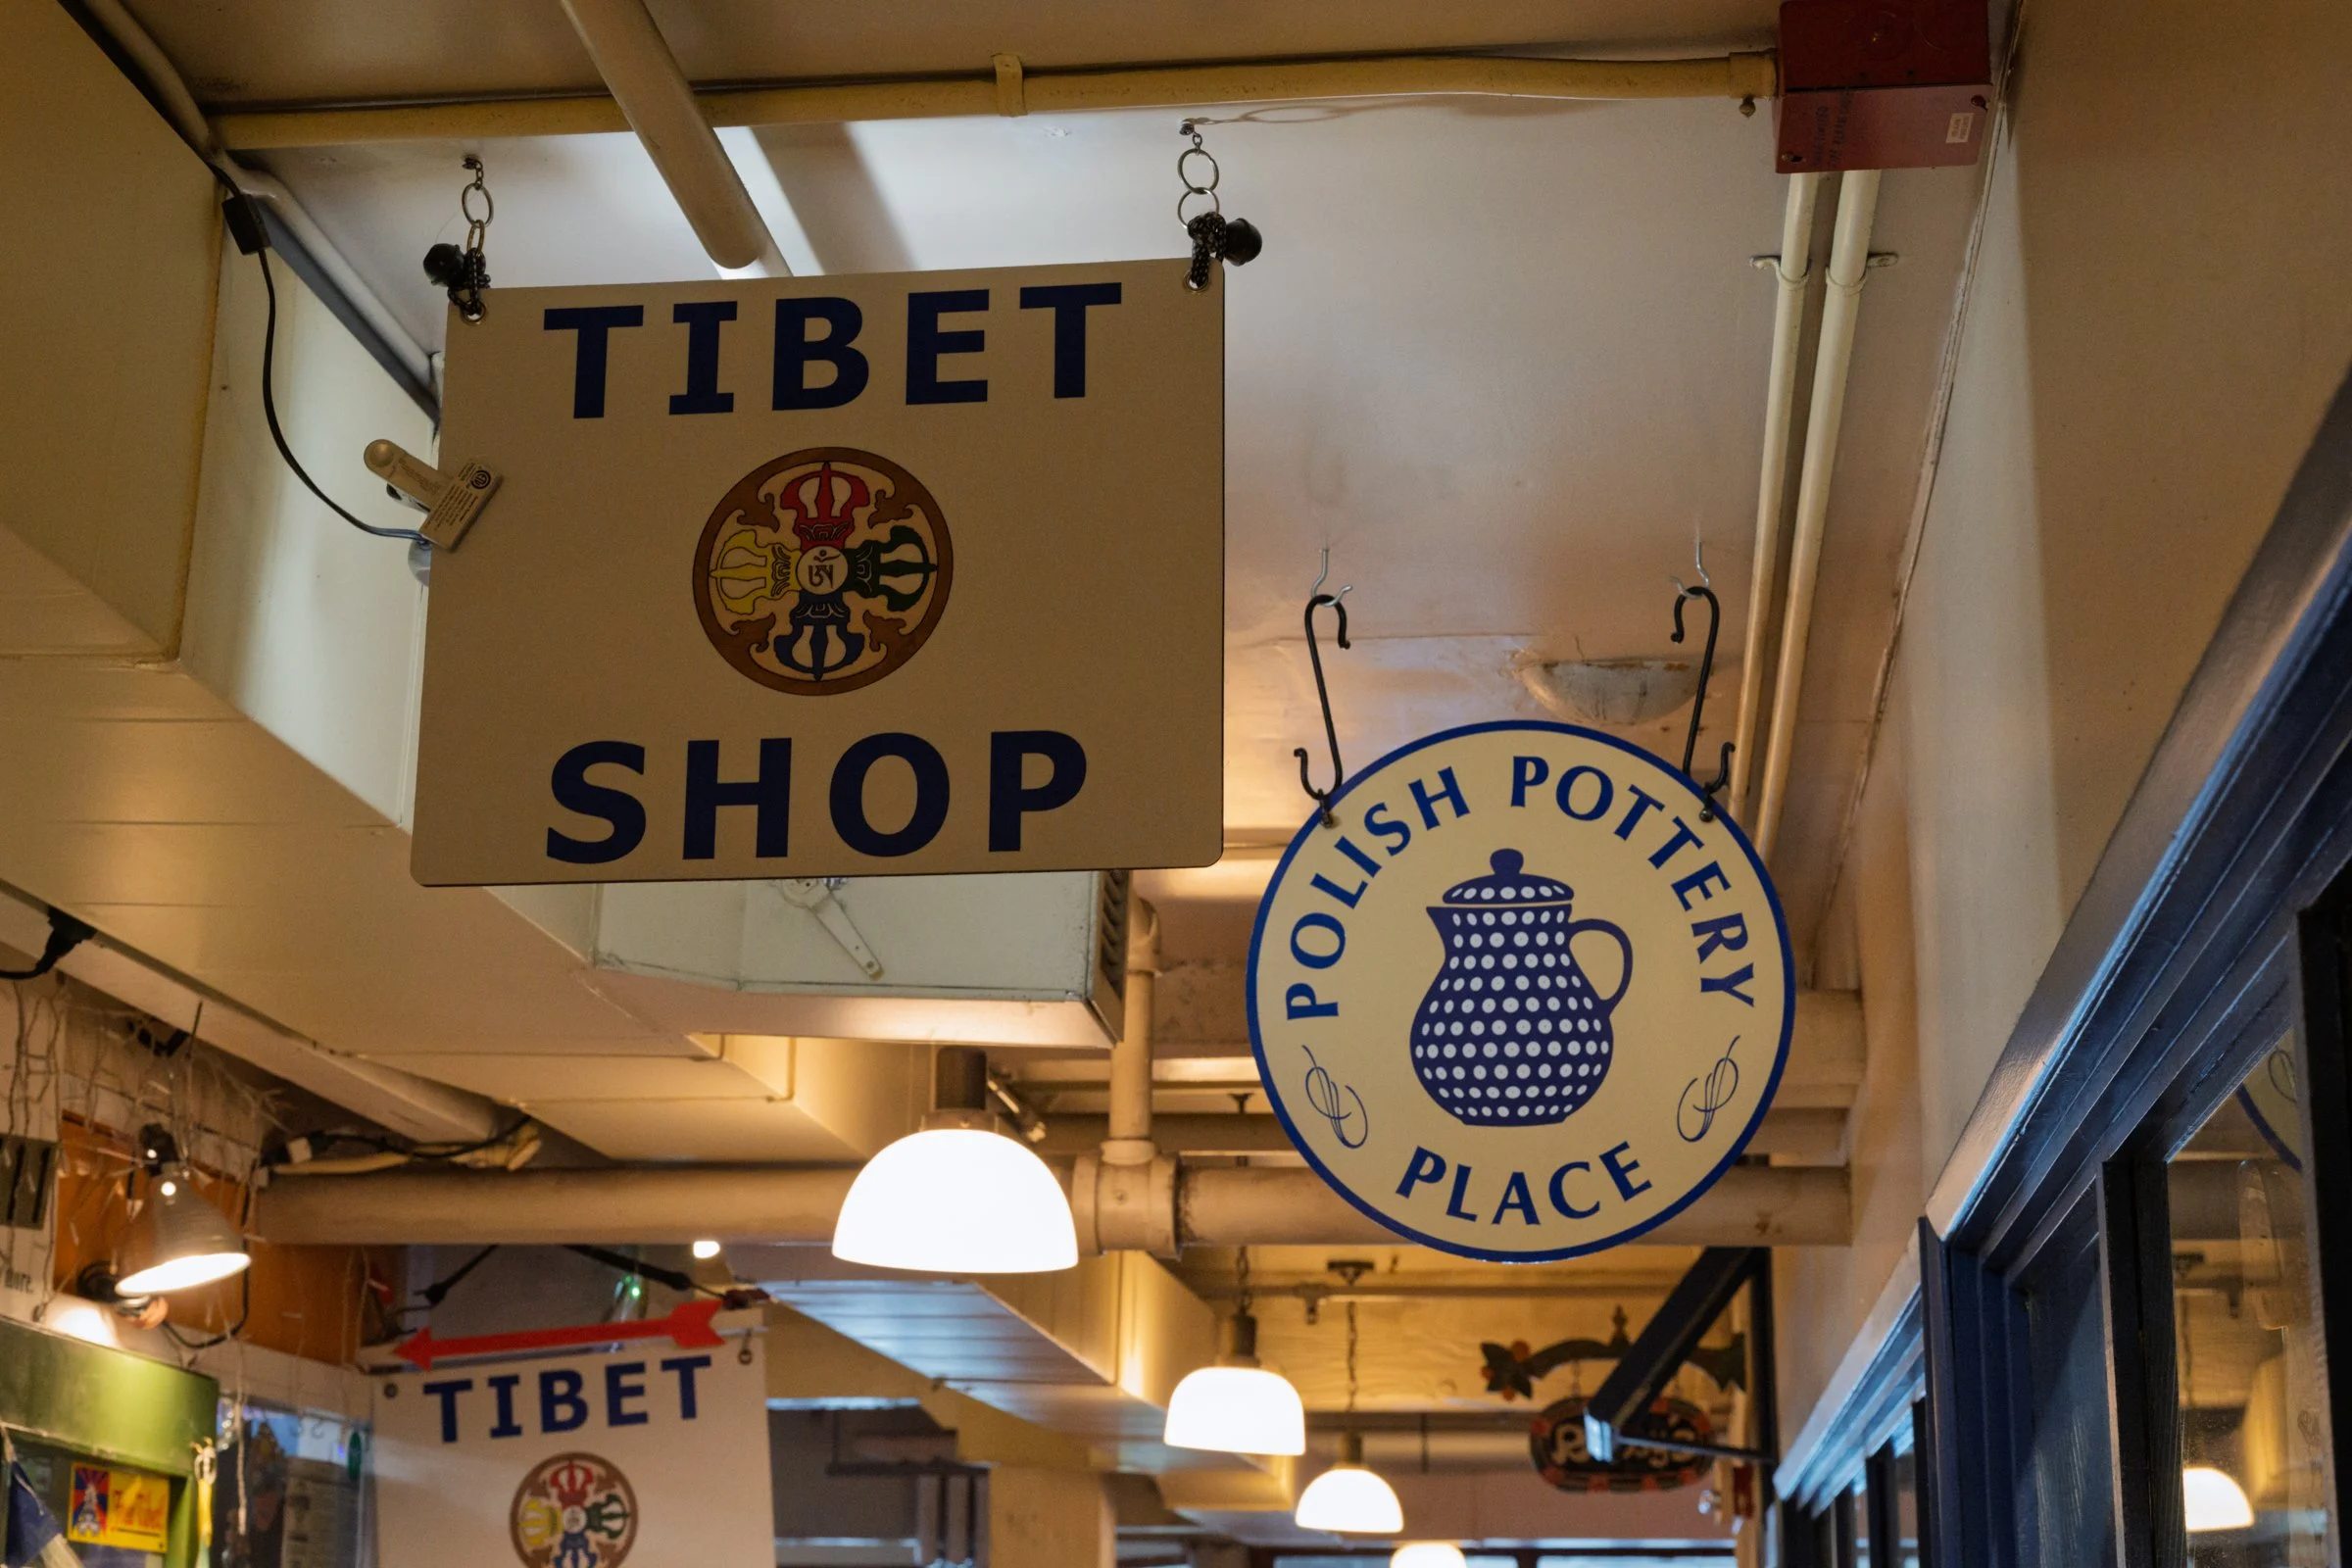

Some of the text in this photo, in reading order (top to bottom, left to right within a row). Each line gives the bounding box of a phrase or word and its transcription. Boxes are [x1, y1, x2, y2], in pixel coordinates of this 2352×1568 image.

[543, 281, 1122, 419] TIBET
[546, 729, 1087, 864] SHOP
[1285, 756, 1754, 1020] POLISH POTTERY
[1396, 1141, 1652, 1225] PLACE
[422, 1354, 712, 1444] TIBET
